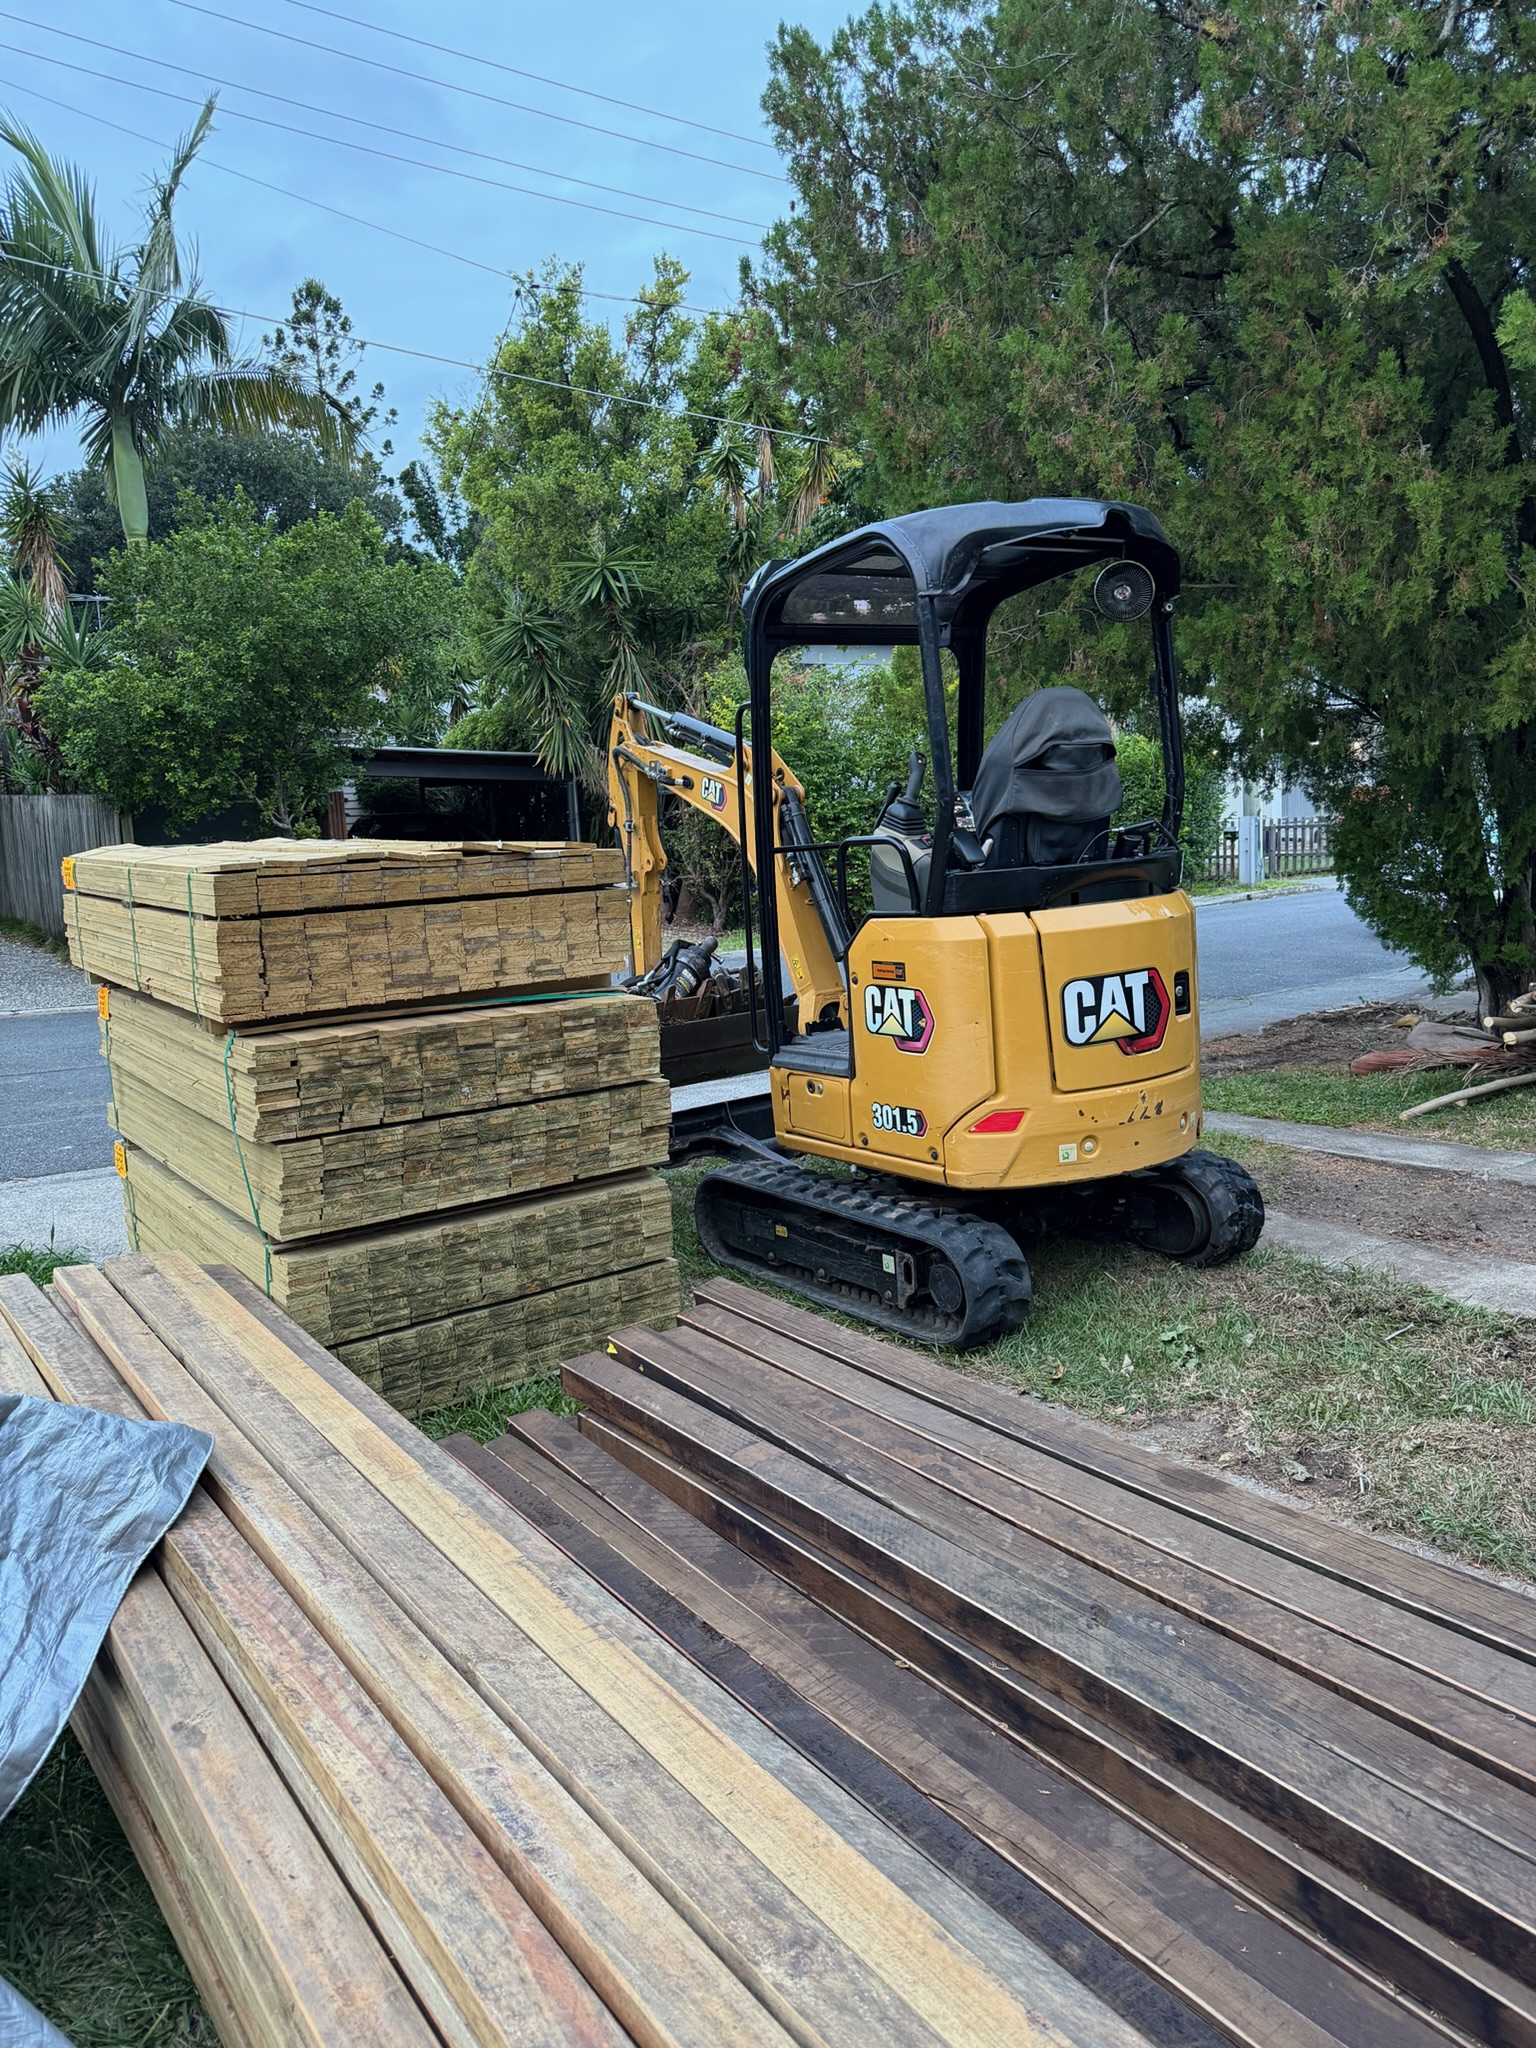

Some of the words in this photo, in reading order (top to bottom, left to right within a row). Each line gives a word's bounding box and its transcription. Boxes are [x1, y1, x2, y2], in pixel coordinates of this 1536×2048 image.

[701, 777, 722, 804] CAT
[865, 985, 915, 1037] CAT
[1063, 970, 1149, 1044] CAT
[872, 1102, 918, 1135] 301.5
